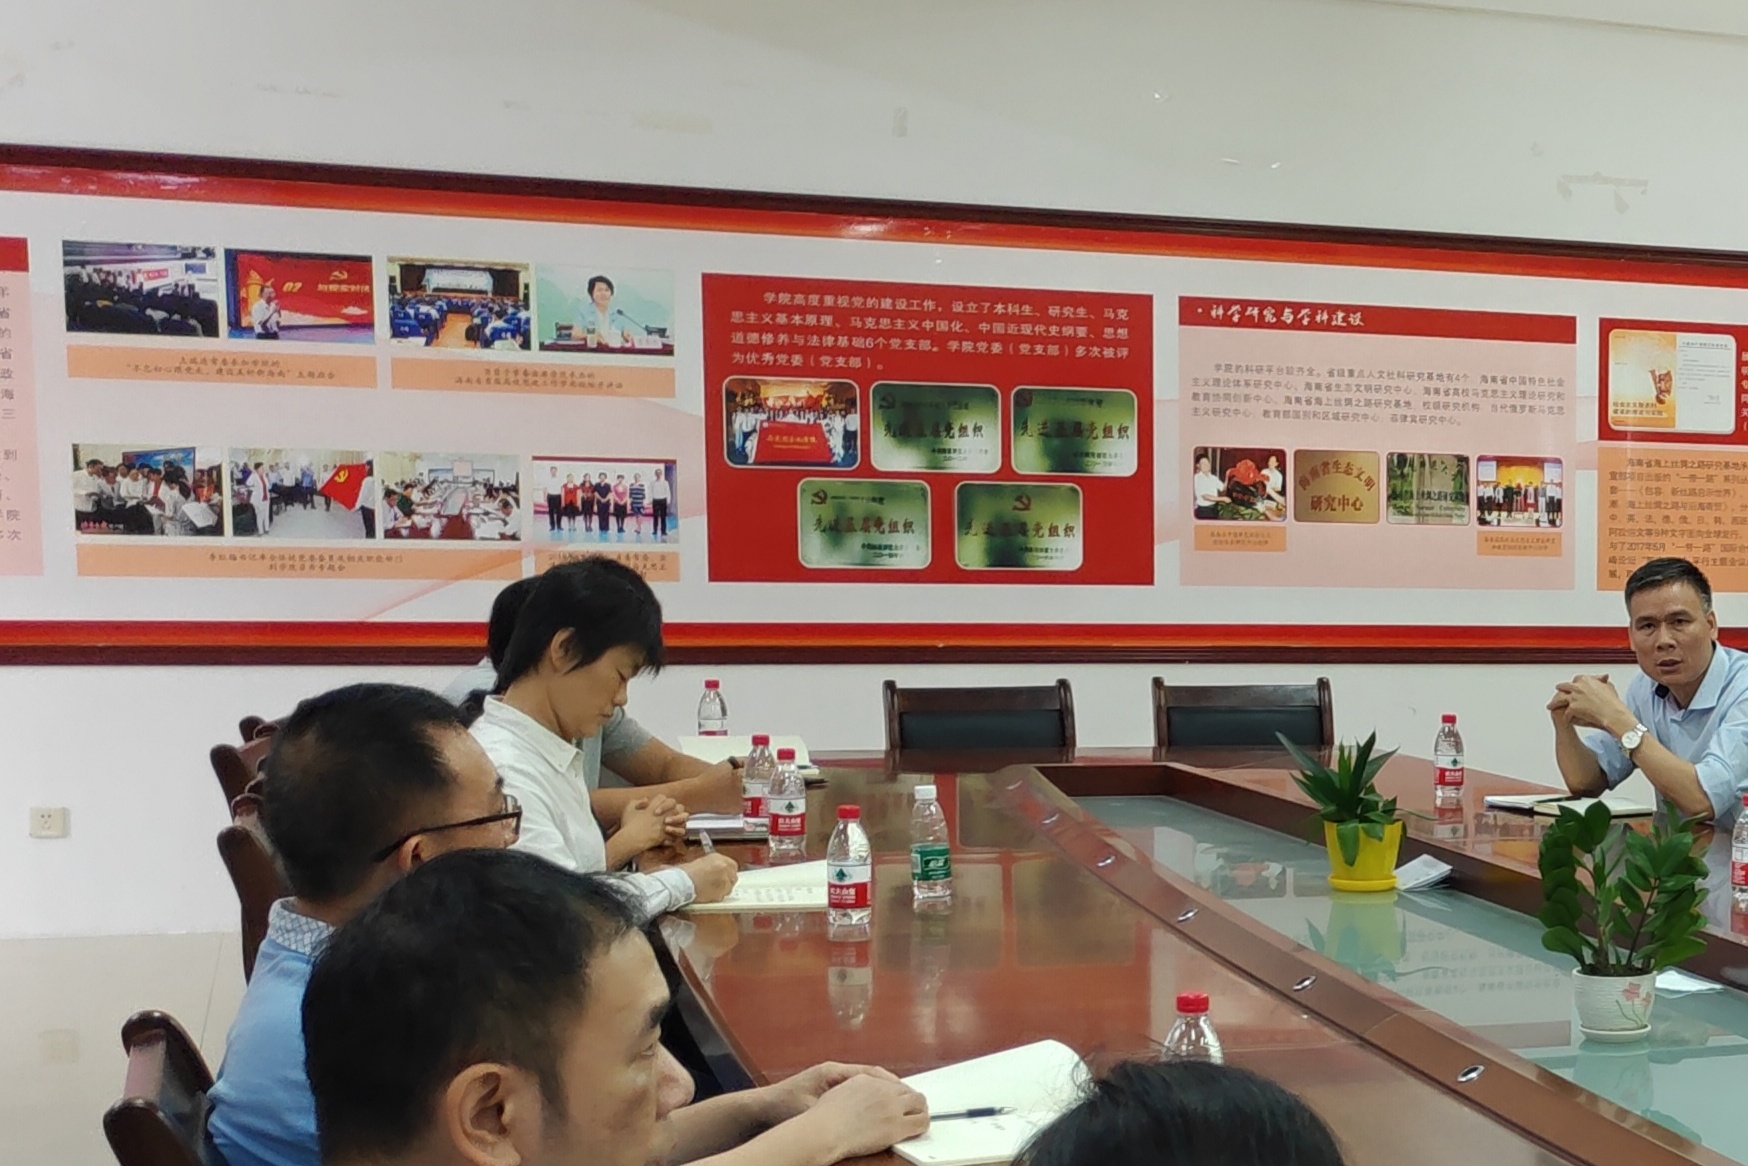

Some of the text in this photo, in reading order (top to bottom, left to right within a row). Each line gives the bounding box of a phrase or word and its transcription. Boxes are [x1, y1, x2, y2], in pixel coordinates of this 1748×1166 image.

[1210, 303, 1365, 327] 科学研究与学科建设
[1309, 493, 1365, 513] 研究中心
